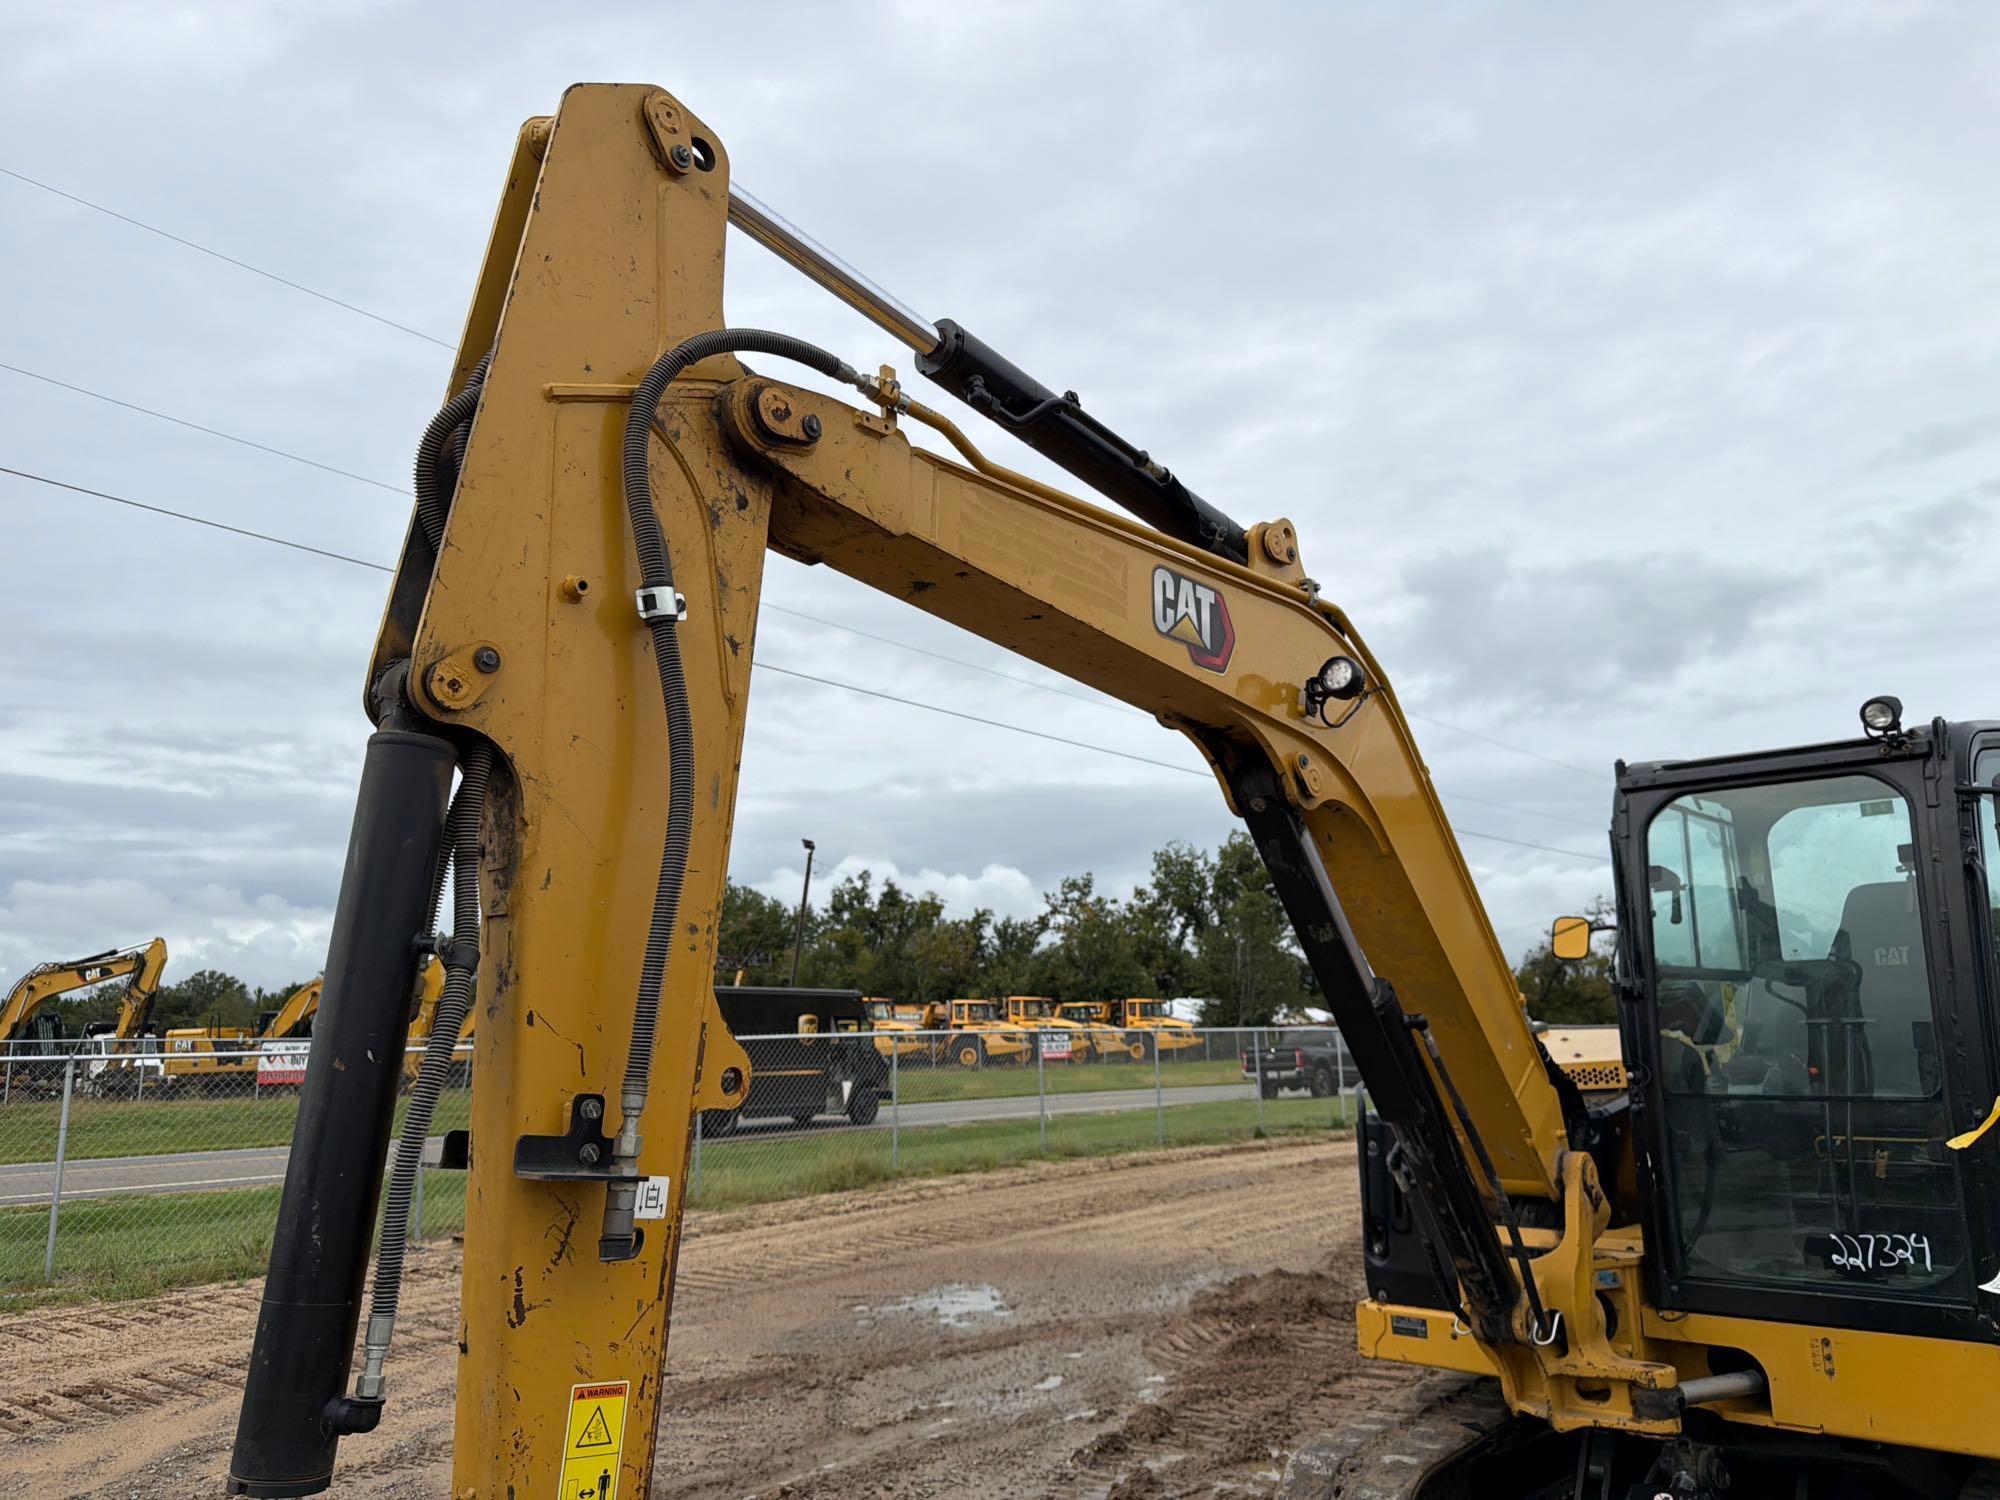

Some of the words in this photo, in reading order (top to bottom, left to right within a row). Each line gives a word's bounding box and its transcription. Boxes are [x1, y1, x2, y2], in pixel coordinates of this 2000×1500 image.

[1153, 567, 1215, 650] CAT
[1874, 946, 1910, 967] CAT
[85, 967, 101, 981] CAT
[174, 1040, 193, 1052] CAT
[1829, 1232, 1932, 1272] 227324
[586, 1386, 623, 1398] WARNING
